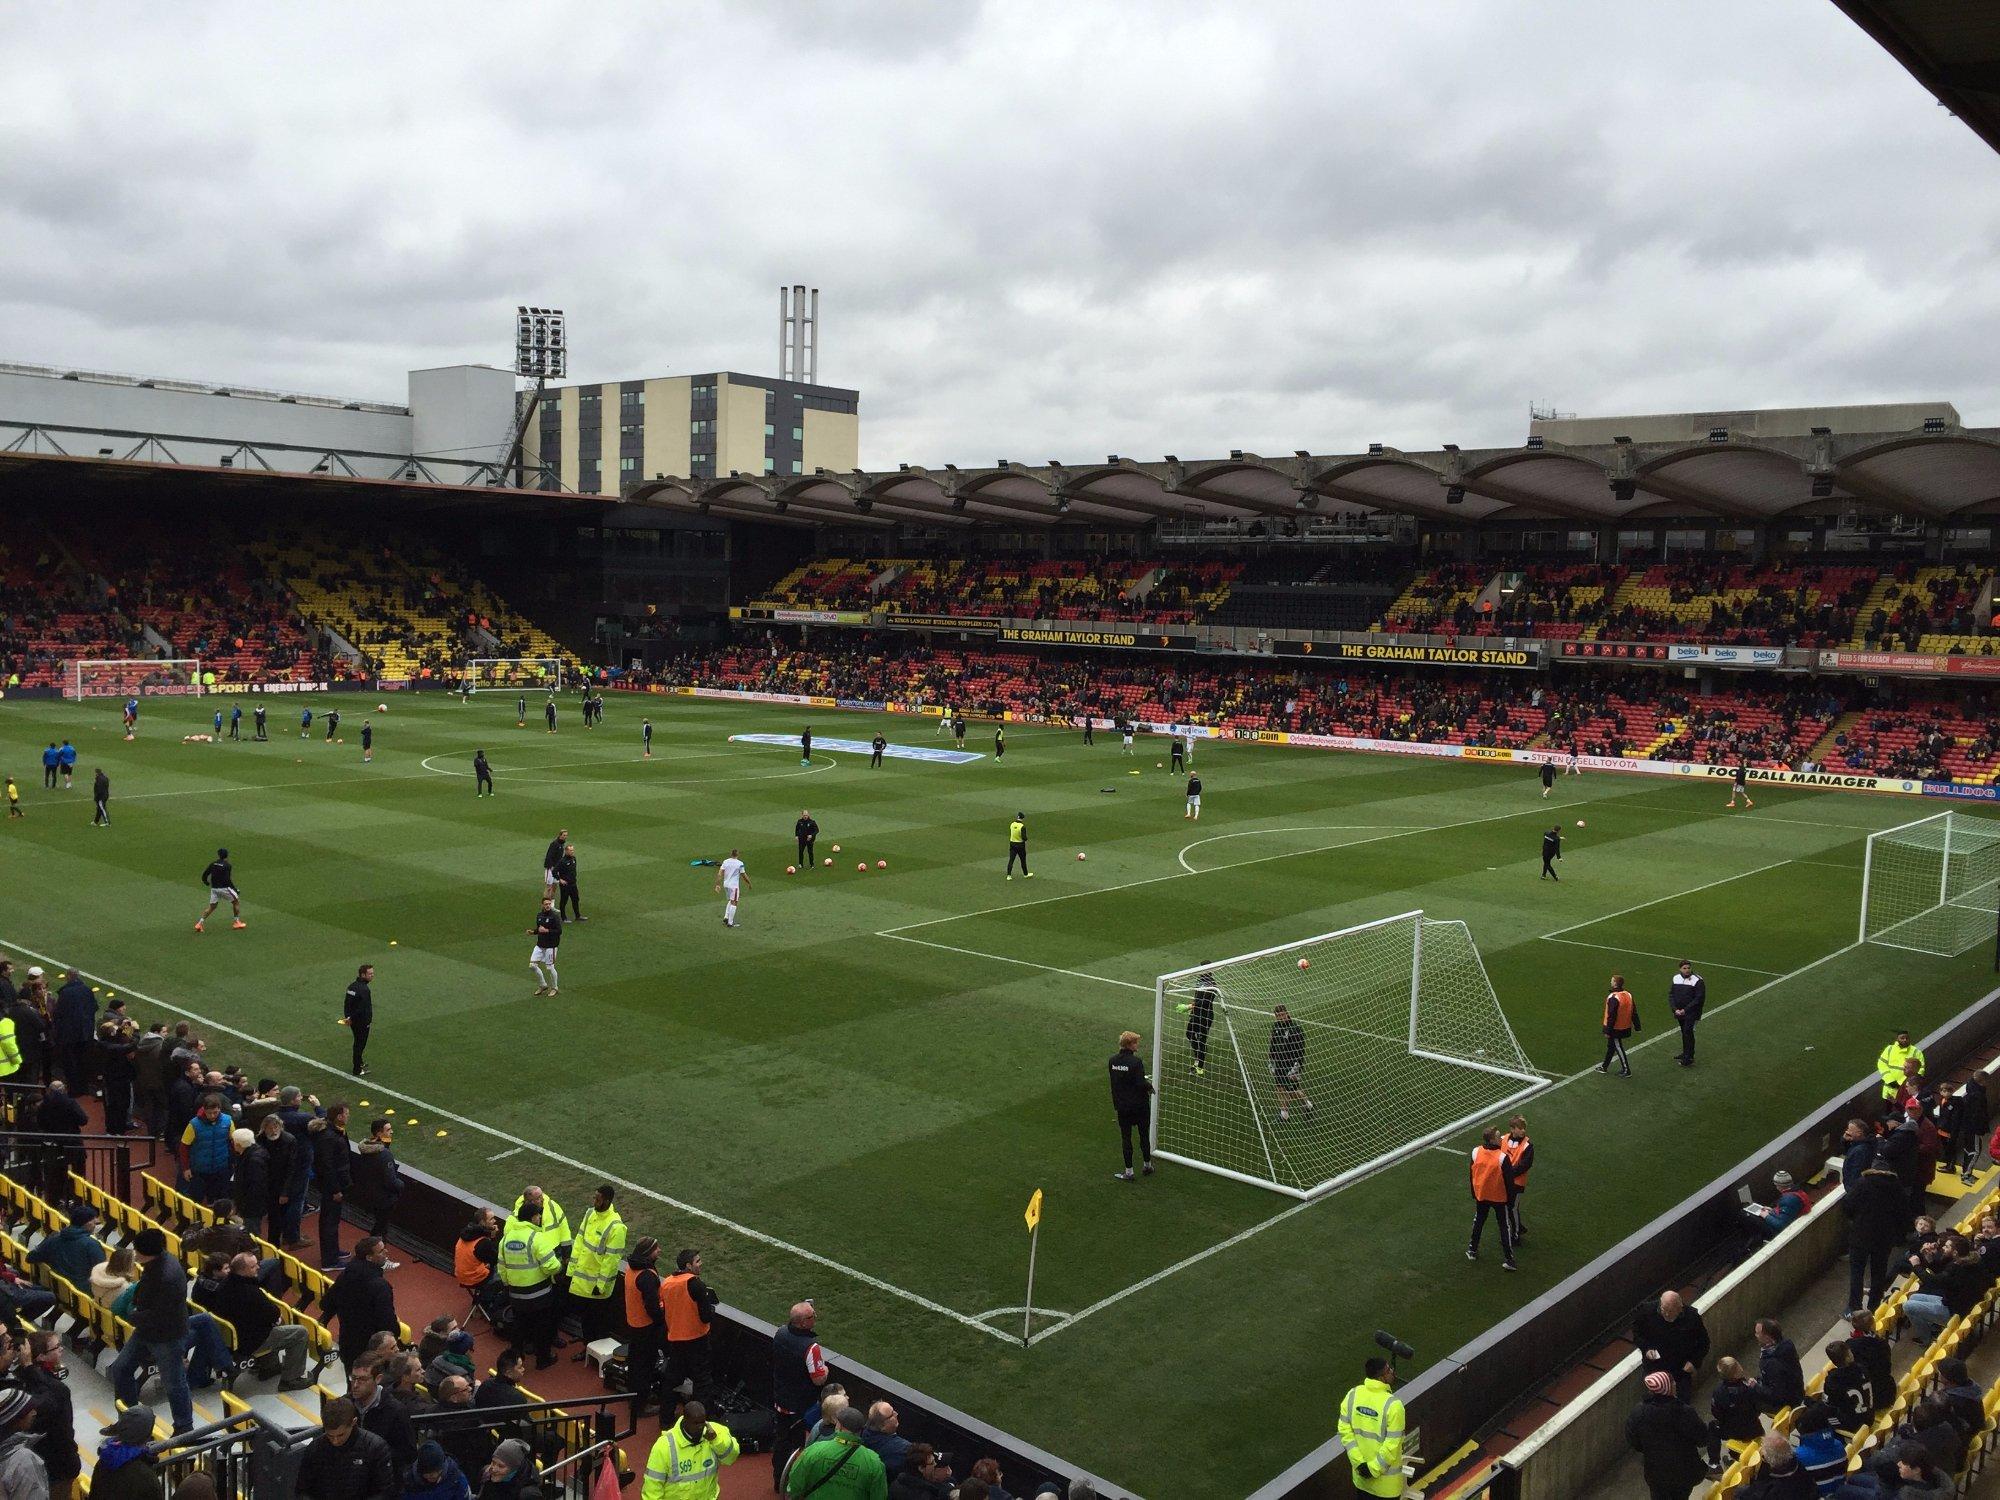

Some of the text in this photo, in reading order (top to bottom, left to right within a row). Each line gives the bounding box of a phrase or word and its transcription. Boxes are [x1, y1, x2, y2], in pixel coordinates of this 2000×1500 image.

[1002, 629, 1135, 646] THE GRAHAM TAYLOR STAND
[1341, 644, 1528, 665] THE GRAHAM TAYLOR STAND
[1677, 647, 1699, 656] beko
[1715, 649, 1738, 658] beko
[1753, 650, 1777, 659] beko
[62, 686, 141, 697] BULLDOG
[144, 685, 206, 696] POWER
[208, 683, 249, 693] SPORT
[252, 684, 260, 692] &
[263, 683, 298, 692] ENERGY
[1235, 729, 1279, 741] 138.com
[1600, 760, 1638, 769] TOYOTA
[1789, 771, 1878, 789] MANAGER
[1923, 784, 1996, 798] BULLDOG
[239, 1357, 255, 1370] CC
[323, 1351, 338, 1364] BB
